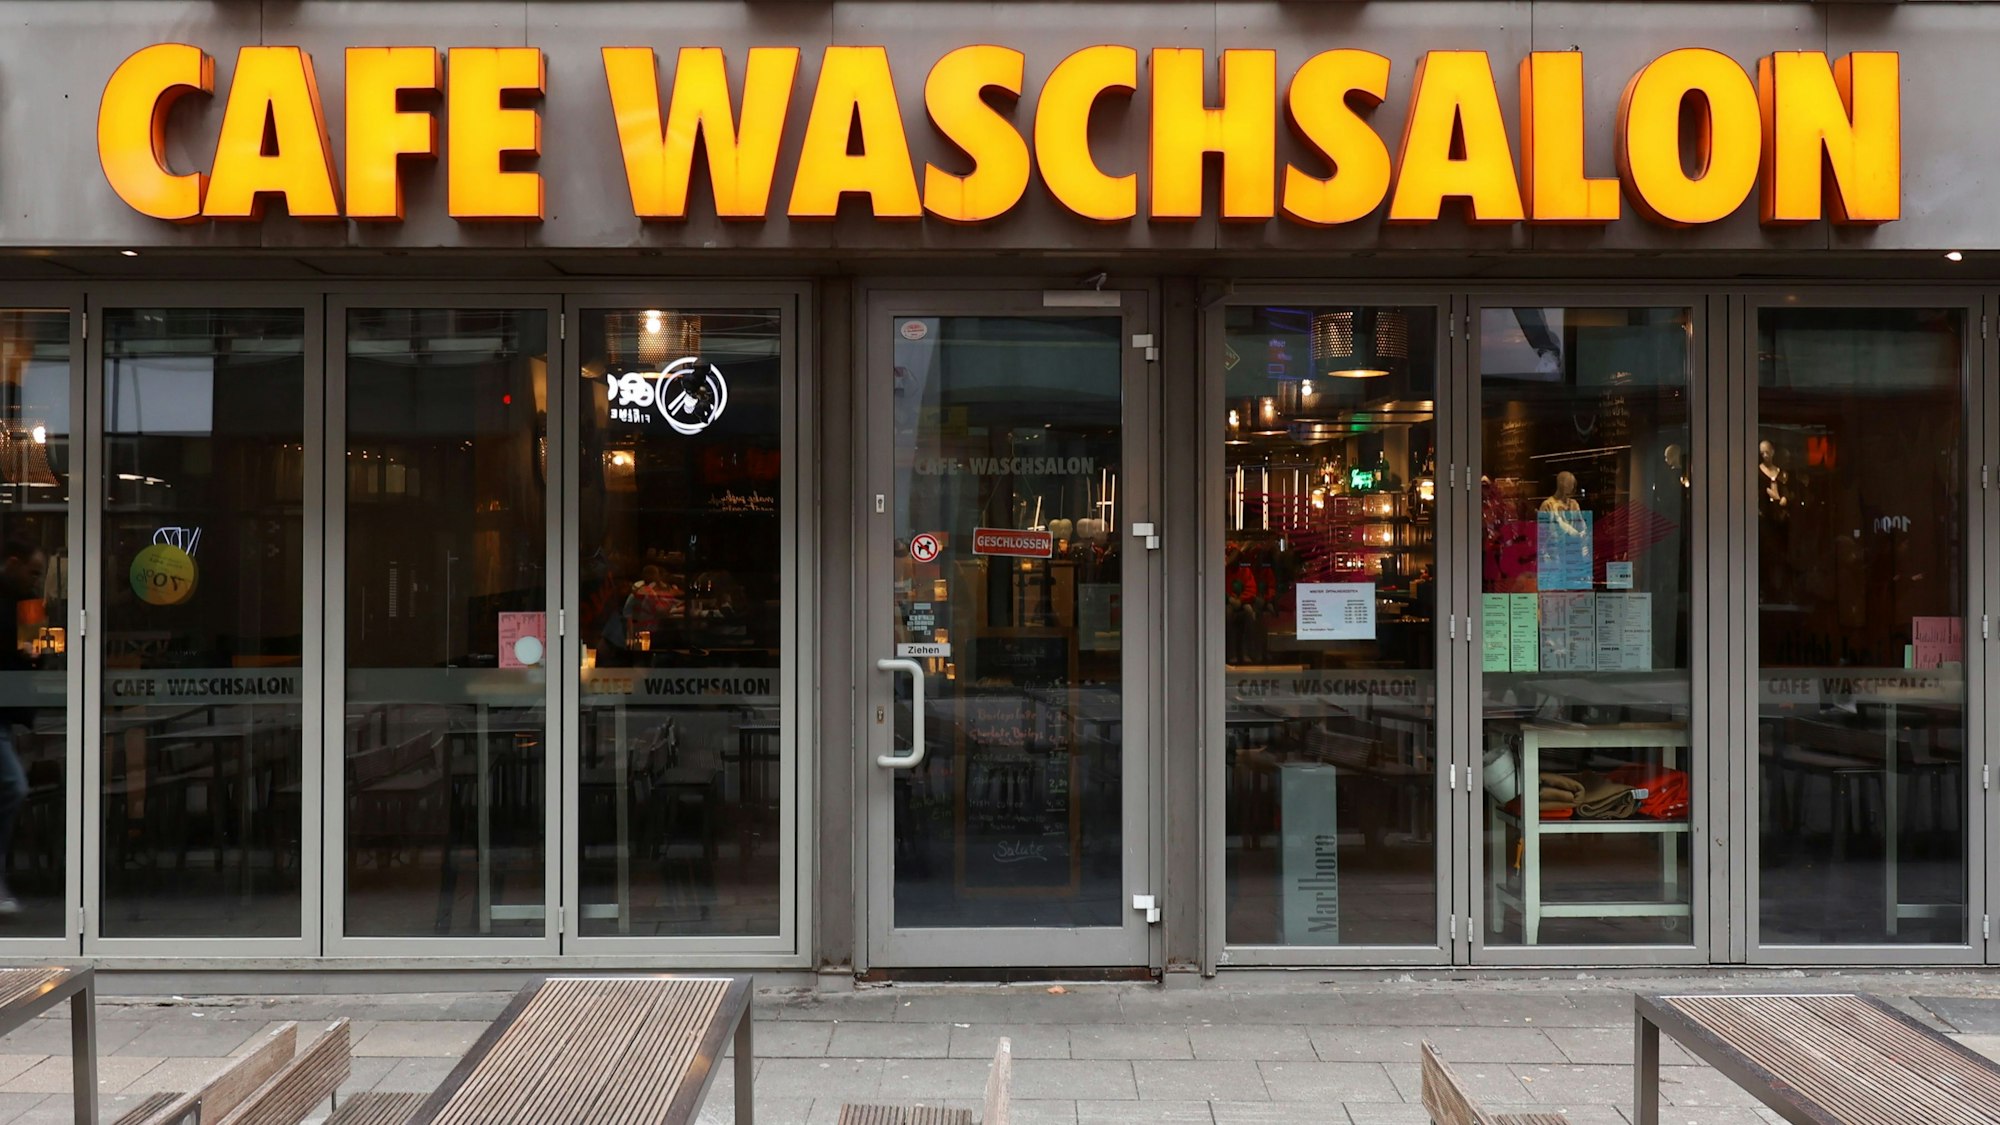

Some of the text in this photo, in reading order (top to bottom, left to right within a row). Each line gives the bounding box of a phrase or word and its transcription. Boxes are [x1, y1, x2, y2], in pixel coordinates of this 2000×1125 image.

[97, 43, 1901, 227] CAFE WASCHSALON
[914, 456, 1094, 475] CAFE WASCHSALON
[976, 535, 1049, 549] GESCHLOSSEN
[907, 646, 940, 654] Ziehen
[112, 677, 294, 696] CAFE WASCHSALON
[590, 678, 768, 695] CAFE WASCHSALON
[1237, 679, 1415, 696] CAFE WASCHSALON
[1767, 678, 1810, 695] CAFE
[1297, 835, 1336, 933] Marlboro
